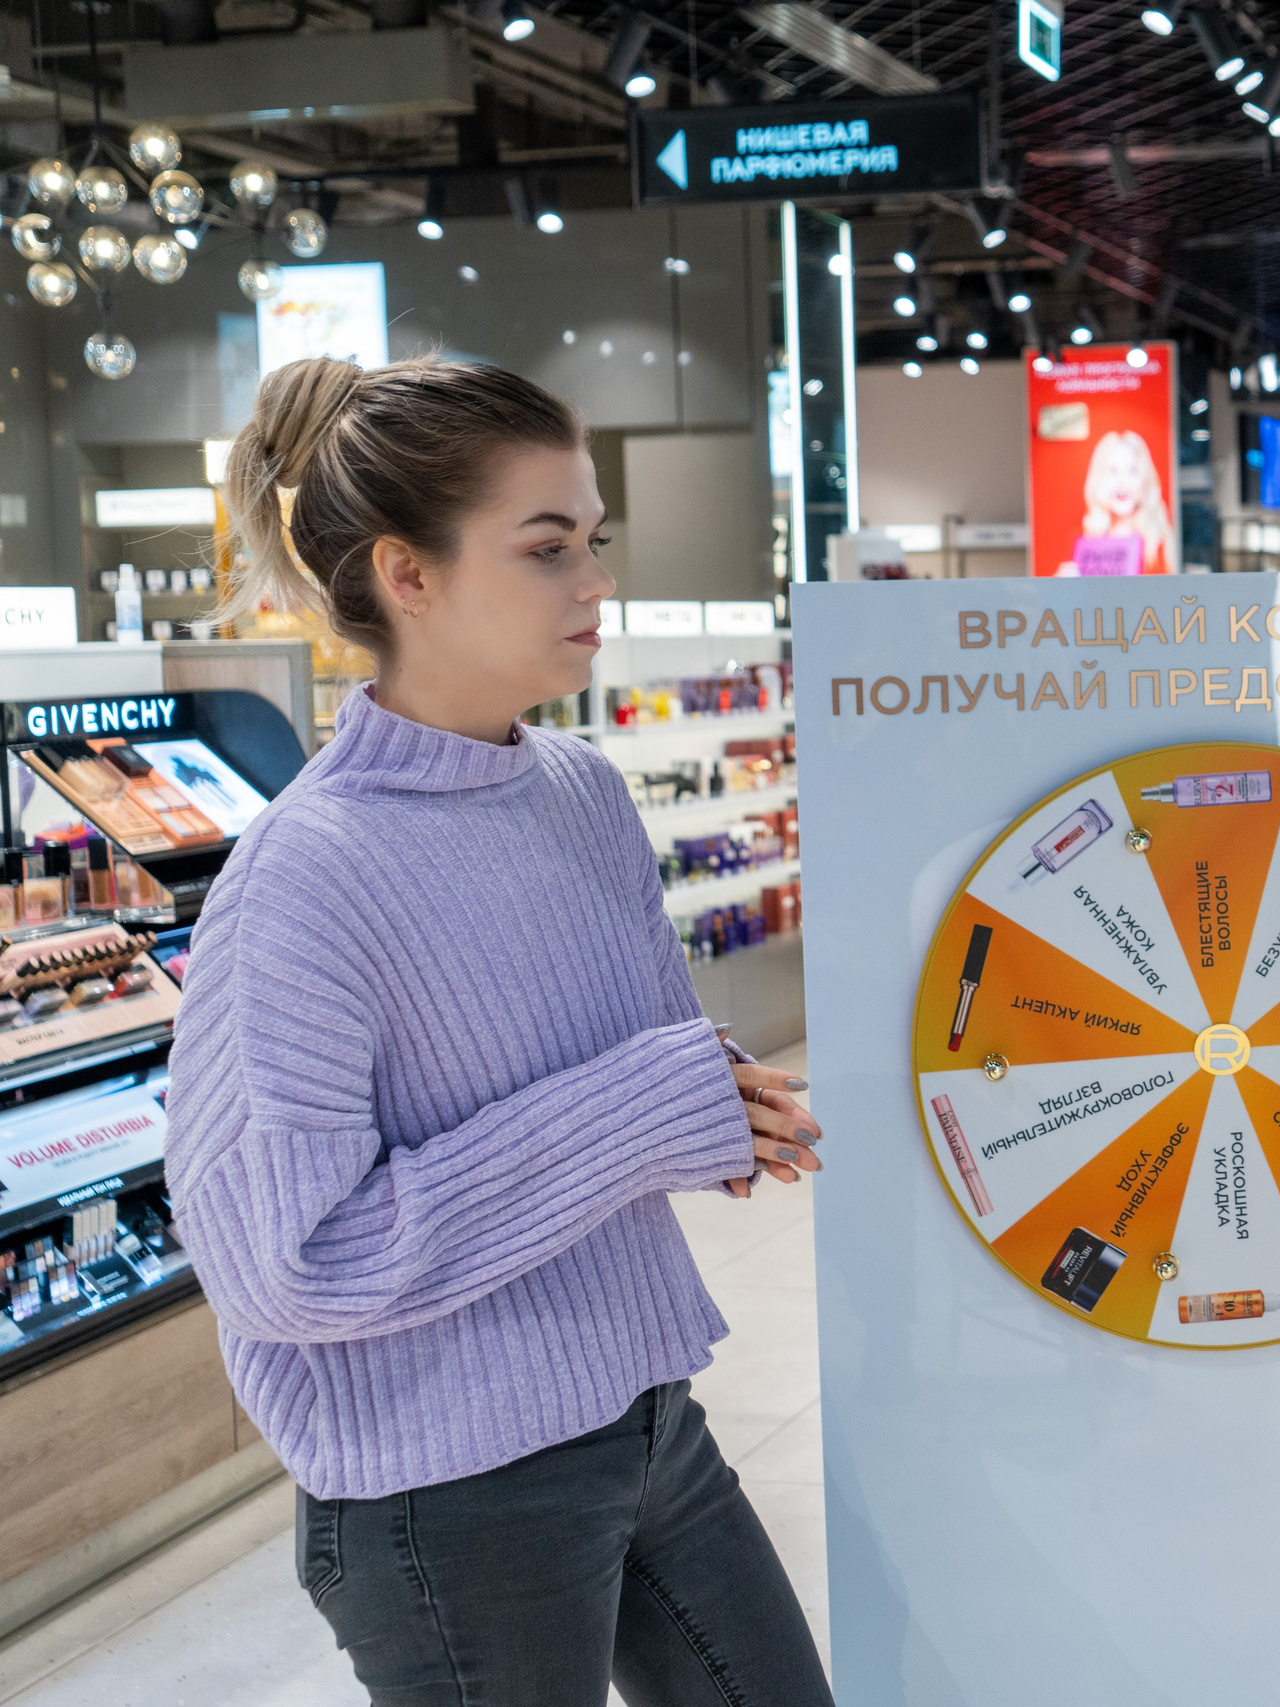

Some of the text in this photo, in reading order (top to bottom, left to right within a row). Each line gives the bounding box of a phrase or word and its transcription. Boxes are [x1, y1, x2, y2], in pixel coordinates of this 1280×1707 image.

[736, 119, 869, 153] НИШЕВАЯ
[711, 145, 898, 184] ПАРФЮМЕРИЯ
[958, 597, 1208, 653] ВРАЩАЙ
[831, 662, 1108, 716] ПОЛУЧАЙ
[27, 699, 175, 736] GIVENCHY
[1074, 885, 1168, 995] УВЛАЖНЕННАЯ
[1119, 905, 1155, 952] КОЖА
[1196, 861, 1214, 967] БЛЕСТЯЩИЕ
[1216, 875, 1231, 951] ВОЛОСЫ
[1011, 995, 1141, 1036] ЯРКИЙ АКЦЕНТ
[981, 1070, 1174, 1161] ГОЛОВОКРУЖИТЕЛЬНЫЙ
[1039, 1081, 1103, 1116] ВЗГЛЯД
[8, 1137, 77, 1169] VOLUME
[75, 1115, 155, 1149] DISTURBIA
[1111, 1121, 1189, 1239] ЭФФЕКТИВНЫЙ
[1116, 1150, 1151, 1193] УХОД
[1213, 1147, 1230, 1228] УКЛАДКА
[1230, 1131, 1249, 1240] РОСКОШНАЯ
